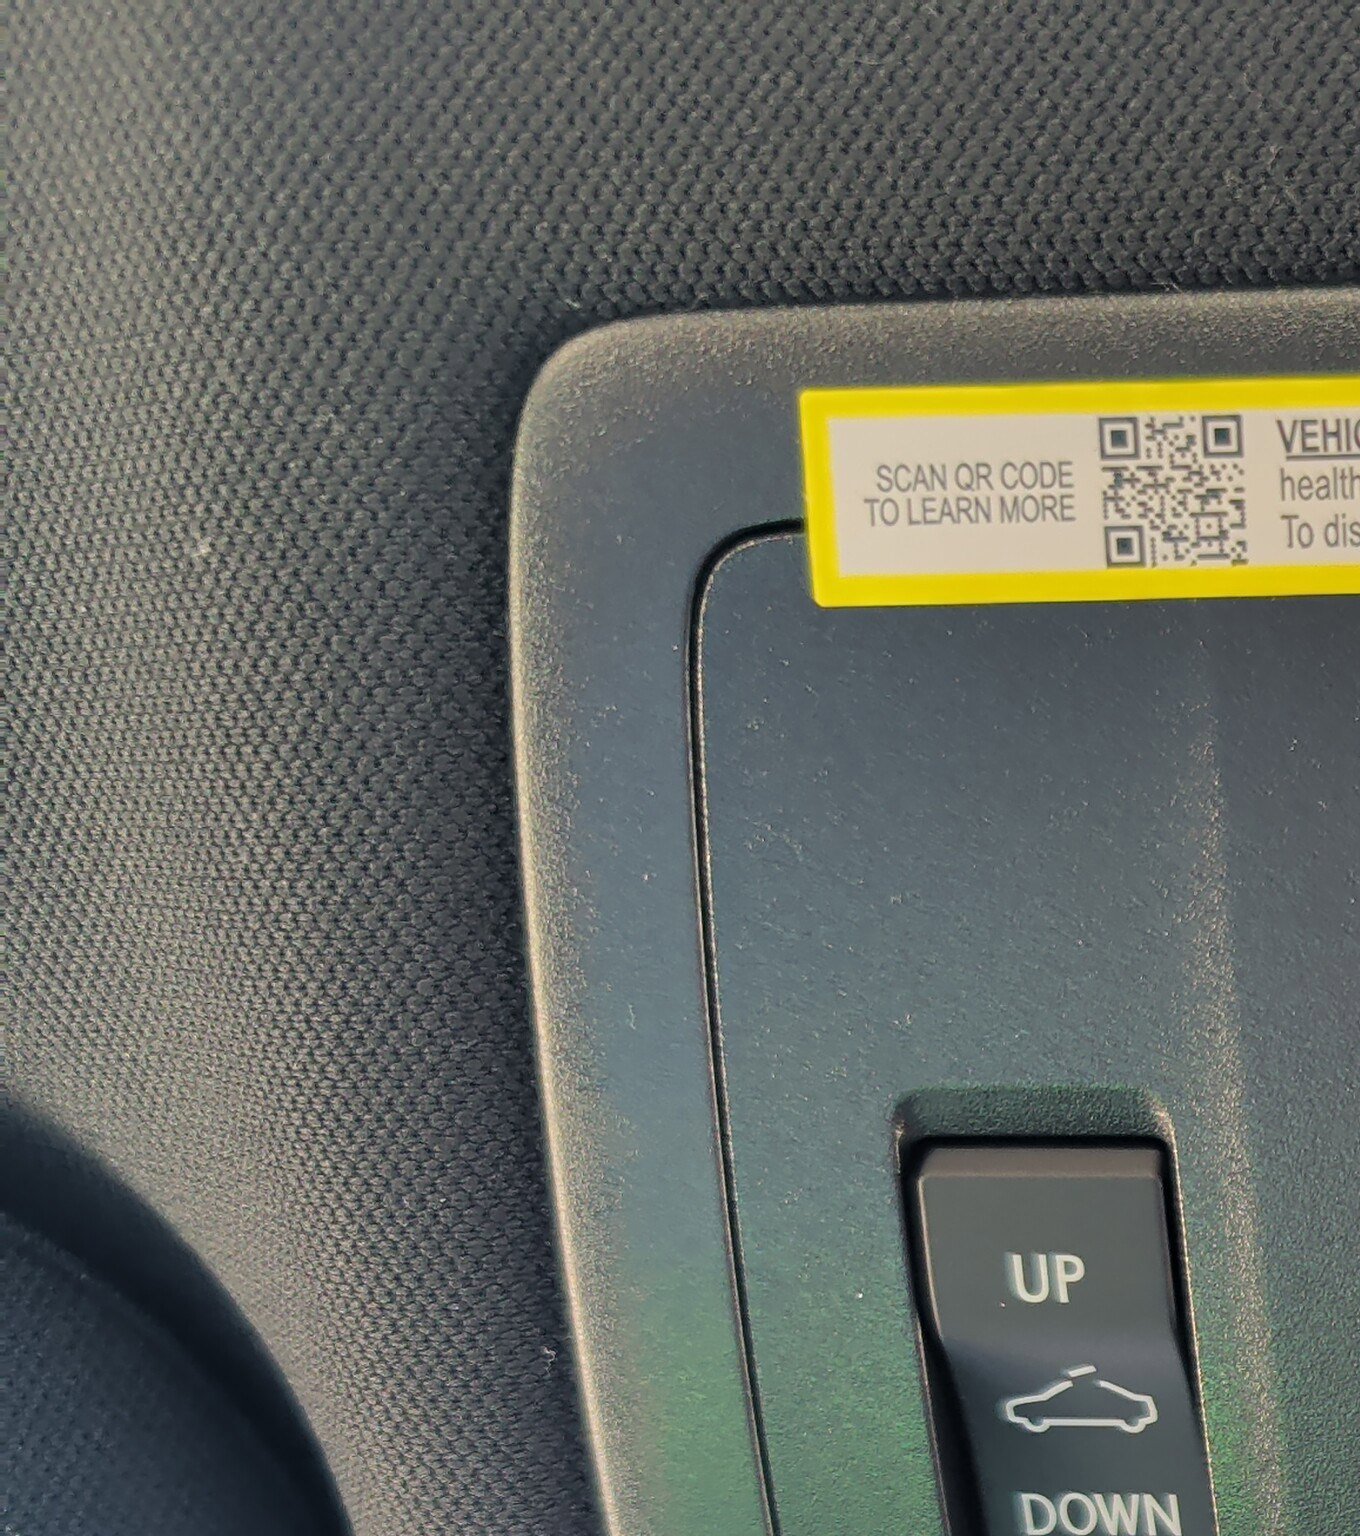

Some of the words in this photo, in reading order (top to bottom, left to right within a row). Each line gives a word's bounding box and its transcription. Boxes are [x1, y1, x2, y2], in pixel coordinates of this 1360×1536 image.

[875, 462, 948, 494] SCAN
[953, 461, 995, 493] QR
[998, 460, 1075, 491] CODE
[862, 496, 900, 528] TO
[905, 494, 992, 527] LEARN
[998, 492, 1077, 524] MORE
[1279, 512, 1316, 550] To
[1008, 1253, 1086, 1303] UP
